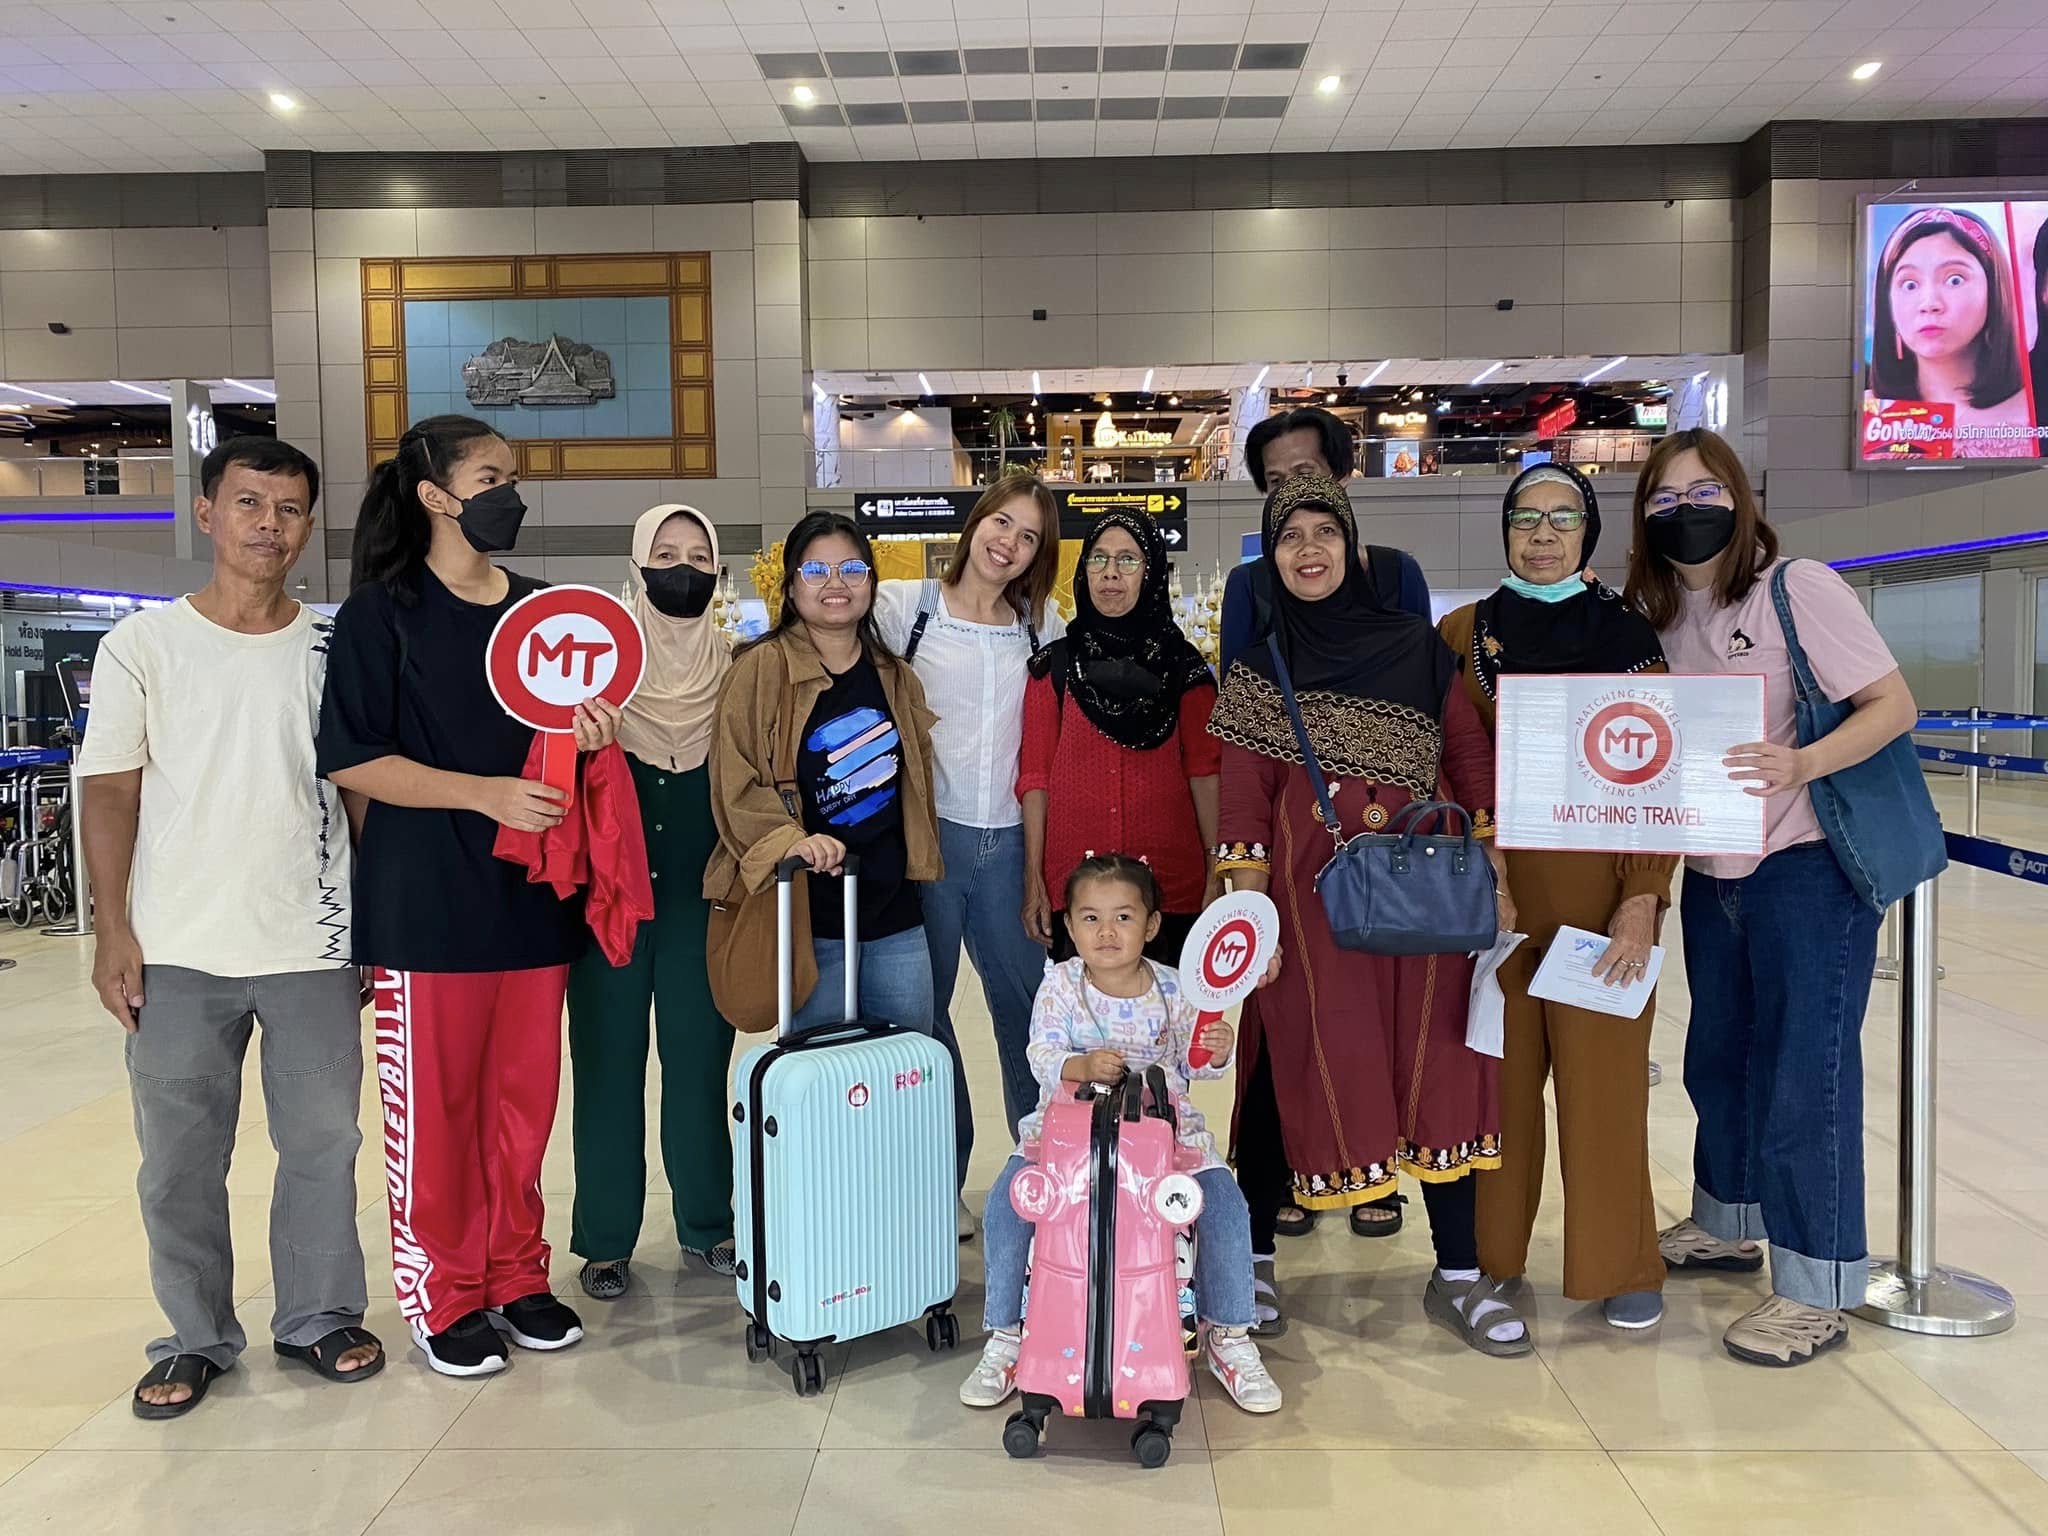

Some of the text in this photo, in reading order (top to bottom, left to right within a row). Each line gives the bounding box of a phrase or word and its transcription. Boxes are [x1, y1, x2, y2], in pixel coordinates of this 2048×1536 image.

[4, 646, 44, 661] Hold Bagg
[527, 632, 613, 687] MT
[1576, 689, 1681, 728] MATCHING TRAVEL
[1605, 727, 1654, 759] MT
[1576, 760, 1682, 797] MATCHING TRAVEL
[1552, 804, 1705, 826] MATCHING TRAVEL
[1206, 908, 1264, 940] MATCHING TRAVEL
[1215, 940, 1246, 968] MT
[1195, 967, 1255, 999] MATCHING TRAVEL
